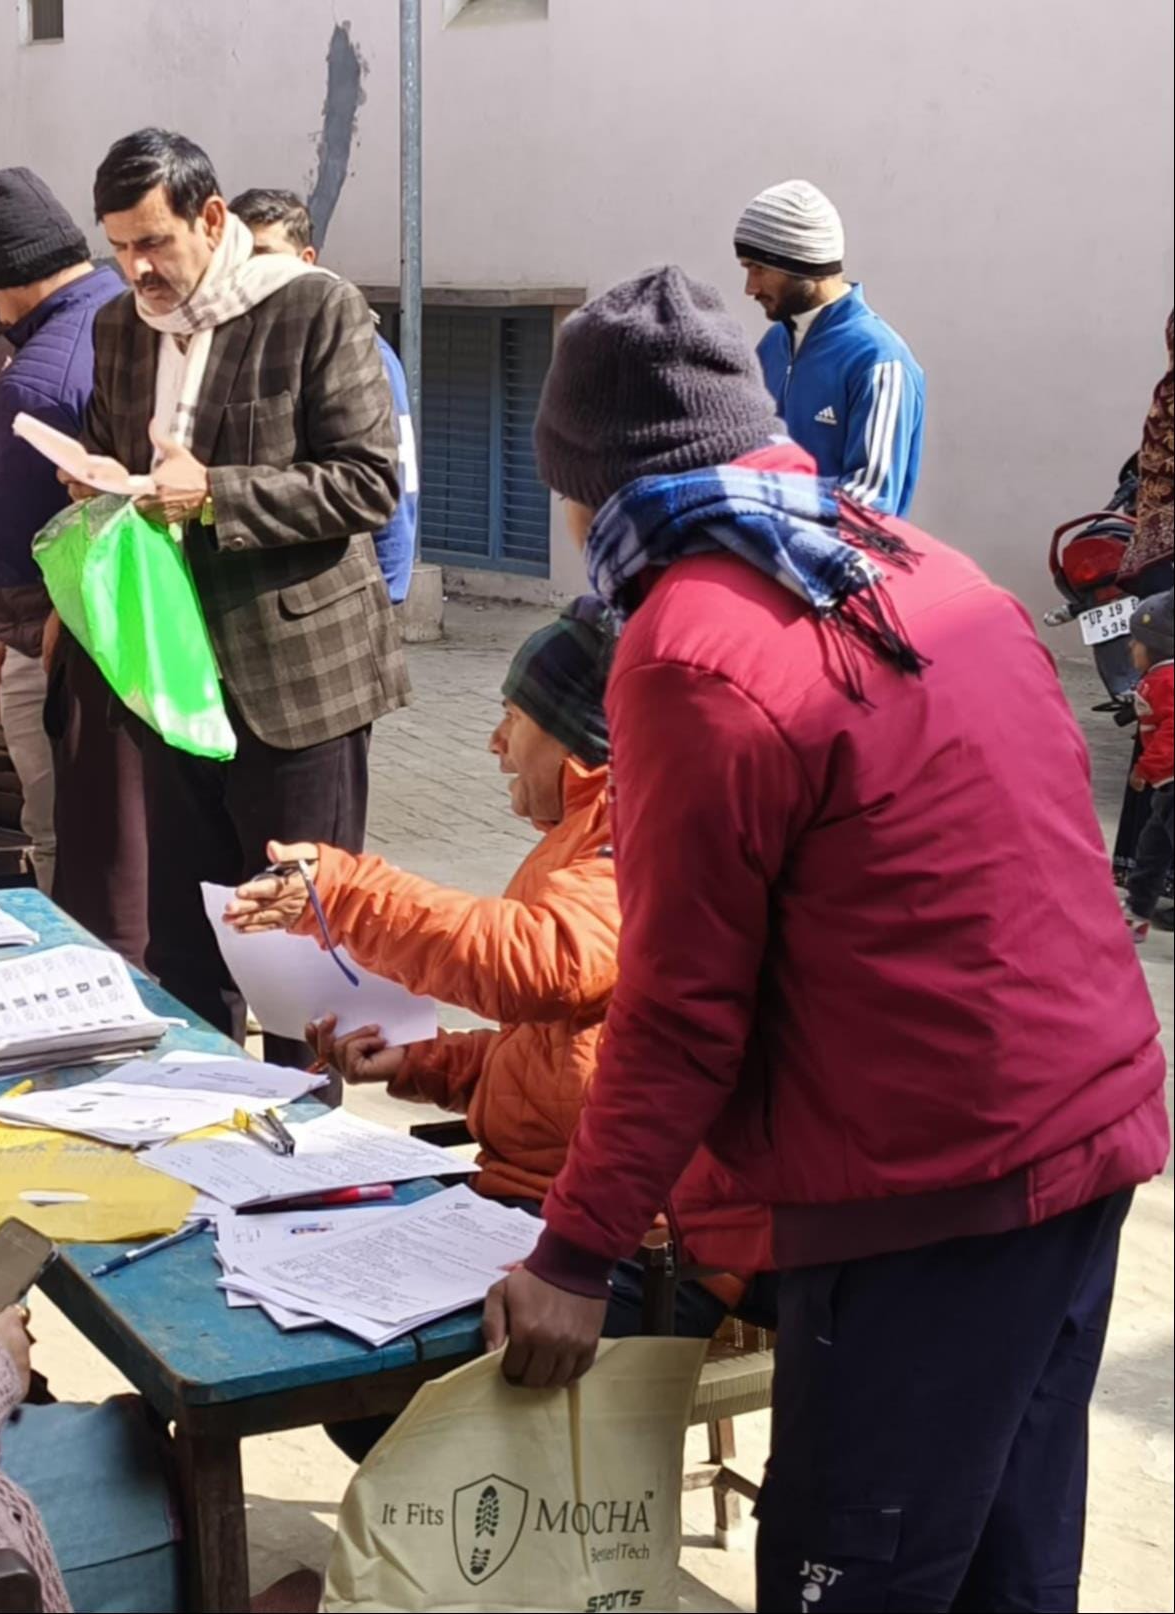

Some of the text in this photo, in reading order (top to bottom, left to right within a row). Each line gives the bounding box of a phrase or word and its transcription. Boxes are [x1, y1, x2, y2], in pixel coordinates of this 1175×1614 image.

[1088, 609, 1104, 625] UP
[1109, 603, 1124, 618] 19
[382, 1502, 445, 1526] It Fits
[534, 1498, 651, 1536] MOCHA
[799, 1560, 844, 1587] JST
